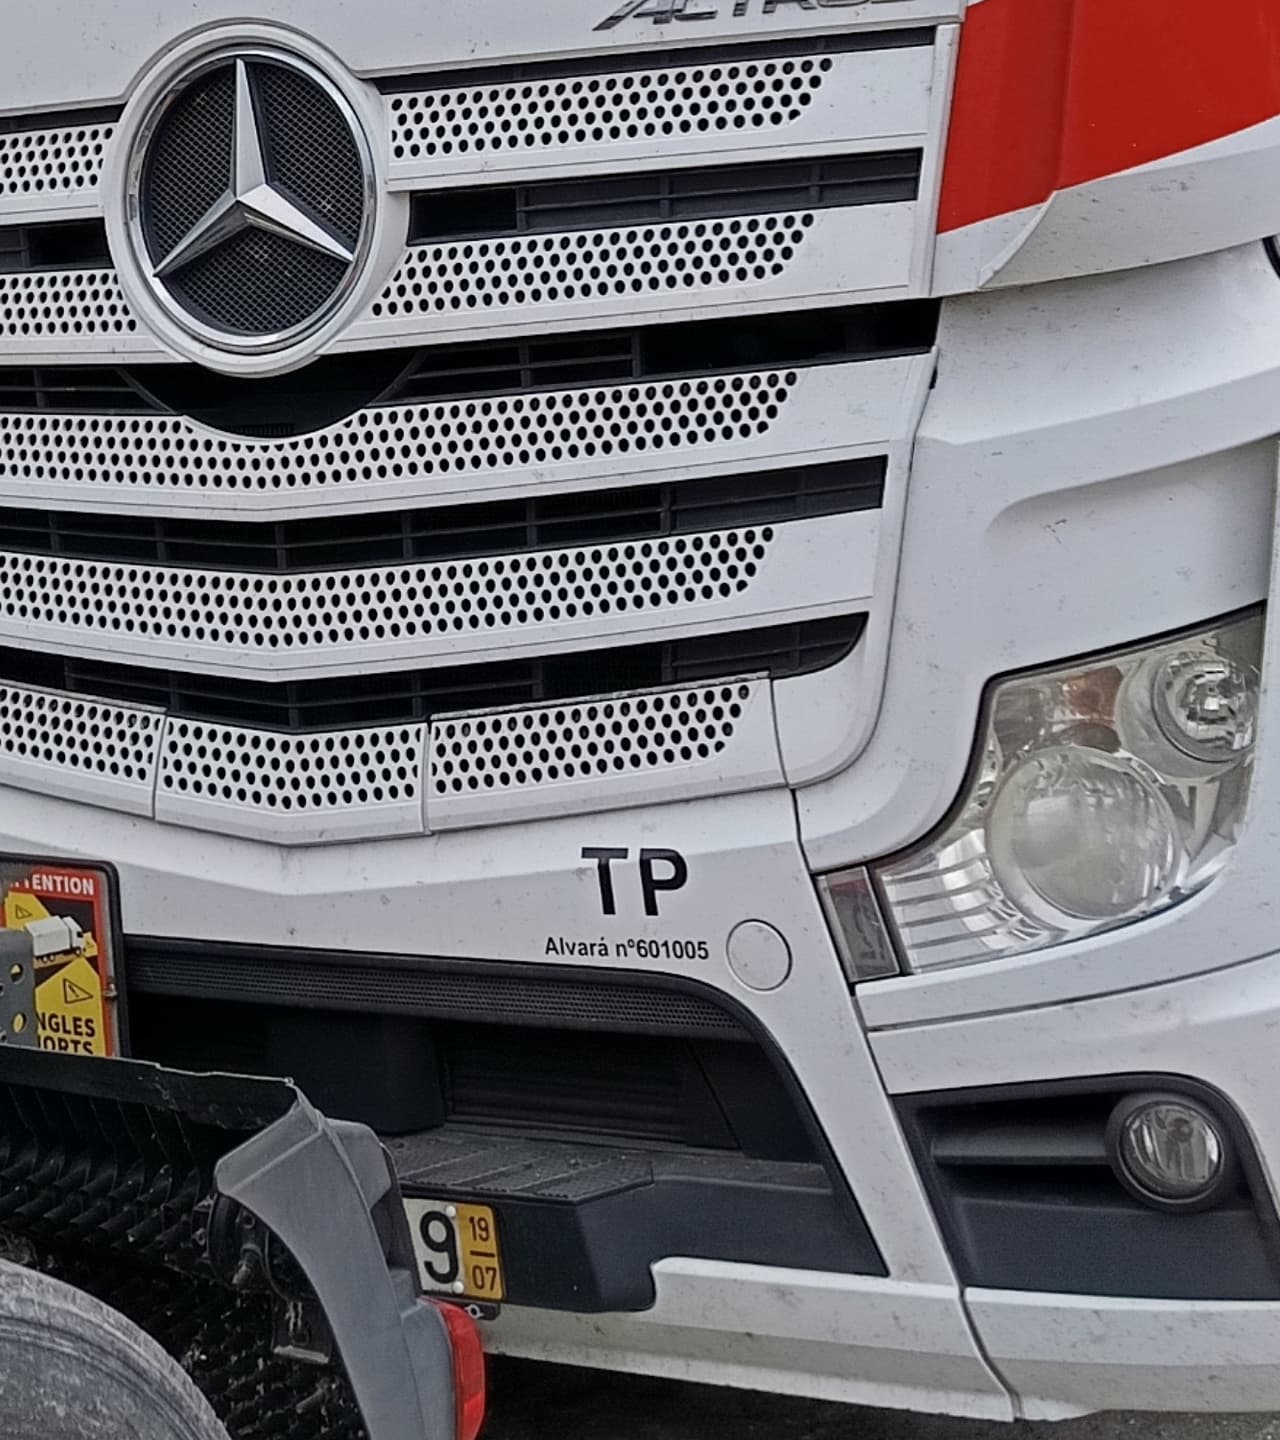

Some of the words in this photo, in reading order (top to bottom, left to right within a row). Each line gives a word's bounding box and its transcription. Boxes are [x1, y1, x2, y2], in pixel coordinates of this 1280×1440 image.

[581, 847, 687, 916] TP
[545, 936, 609, 957] Alvará
[37, 1012, 96, 1037] NGLES
[38, 1035, 94, 1055] ORTS
[469, 1216, 490, 1242] 19
[420, 1210, 459, 1284] 9
[472, 1265, 497, 1292] 07
